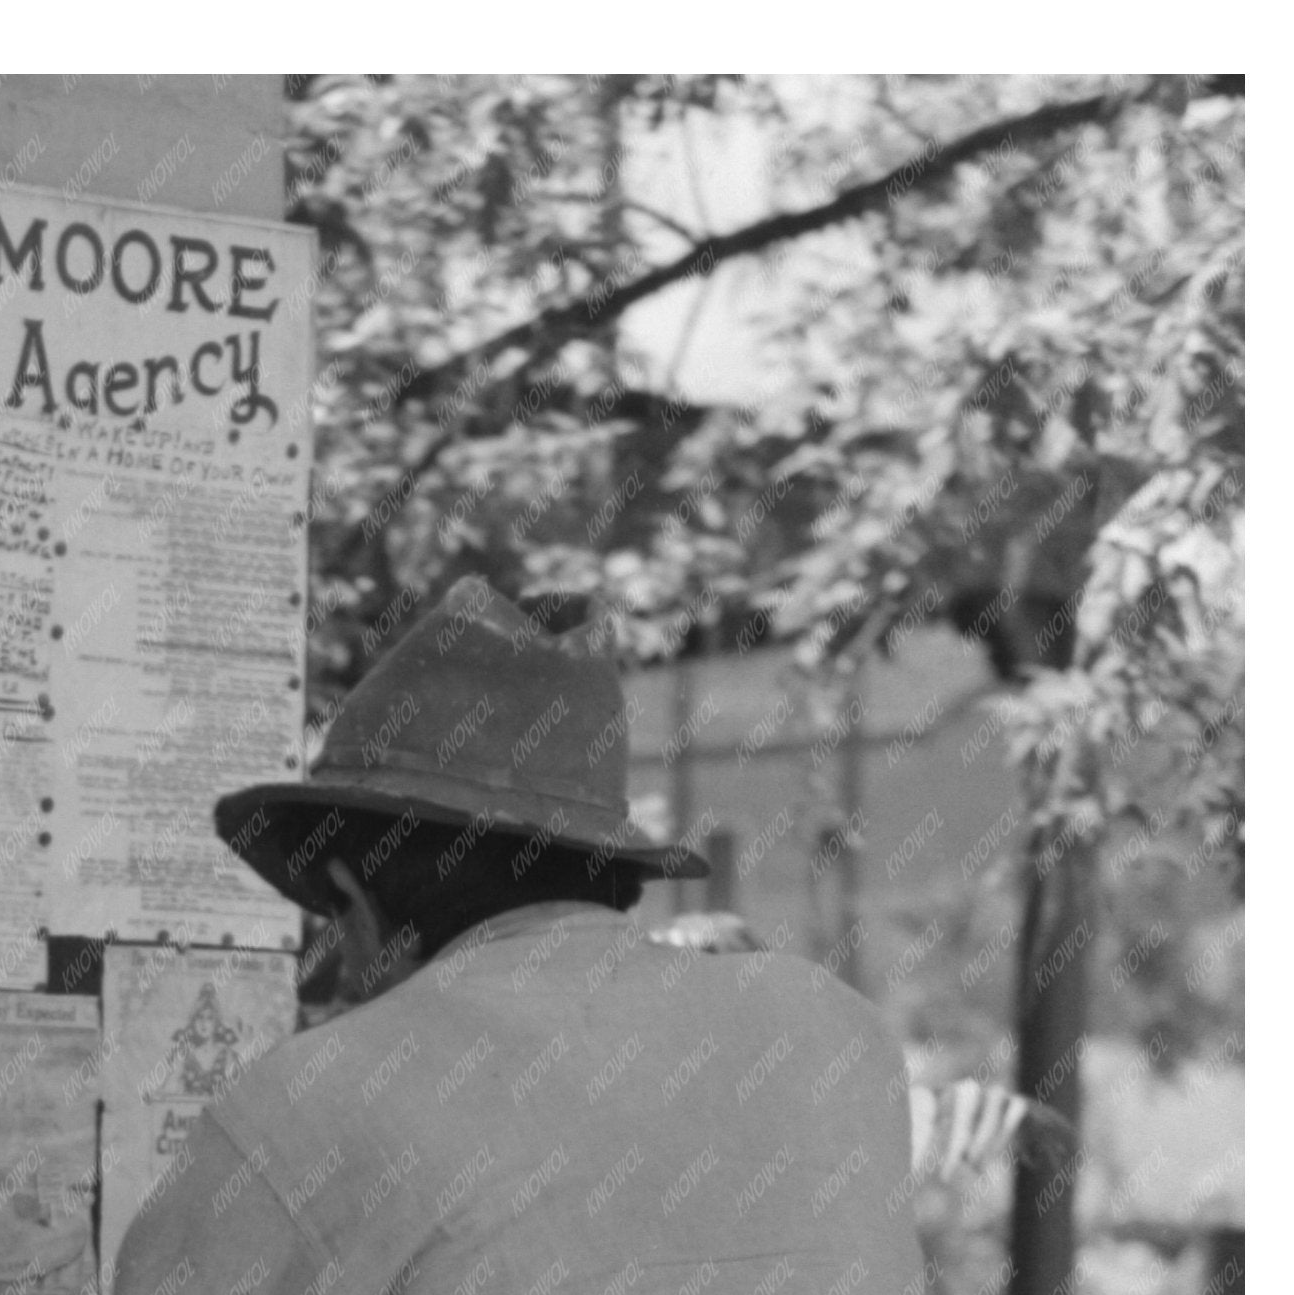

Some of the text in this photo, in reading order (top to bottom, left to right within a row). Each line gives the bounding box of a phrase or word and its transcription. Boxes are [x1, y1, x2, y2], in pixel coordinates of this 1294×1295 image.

[6, 320, 279, 430] Agency
[78, 419, 136, 446] WAKE
[86, 443, 98, 460] A
[107, 447, 163, 471] HOME
[169, 456, 196, 476] OF
[202, 462, 246, 482] YOUR
[16, 1001, 78, 1024] Expected
